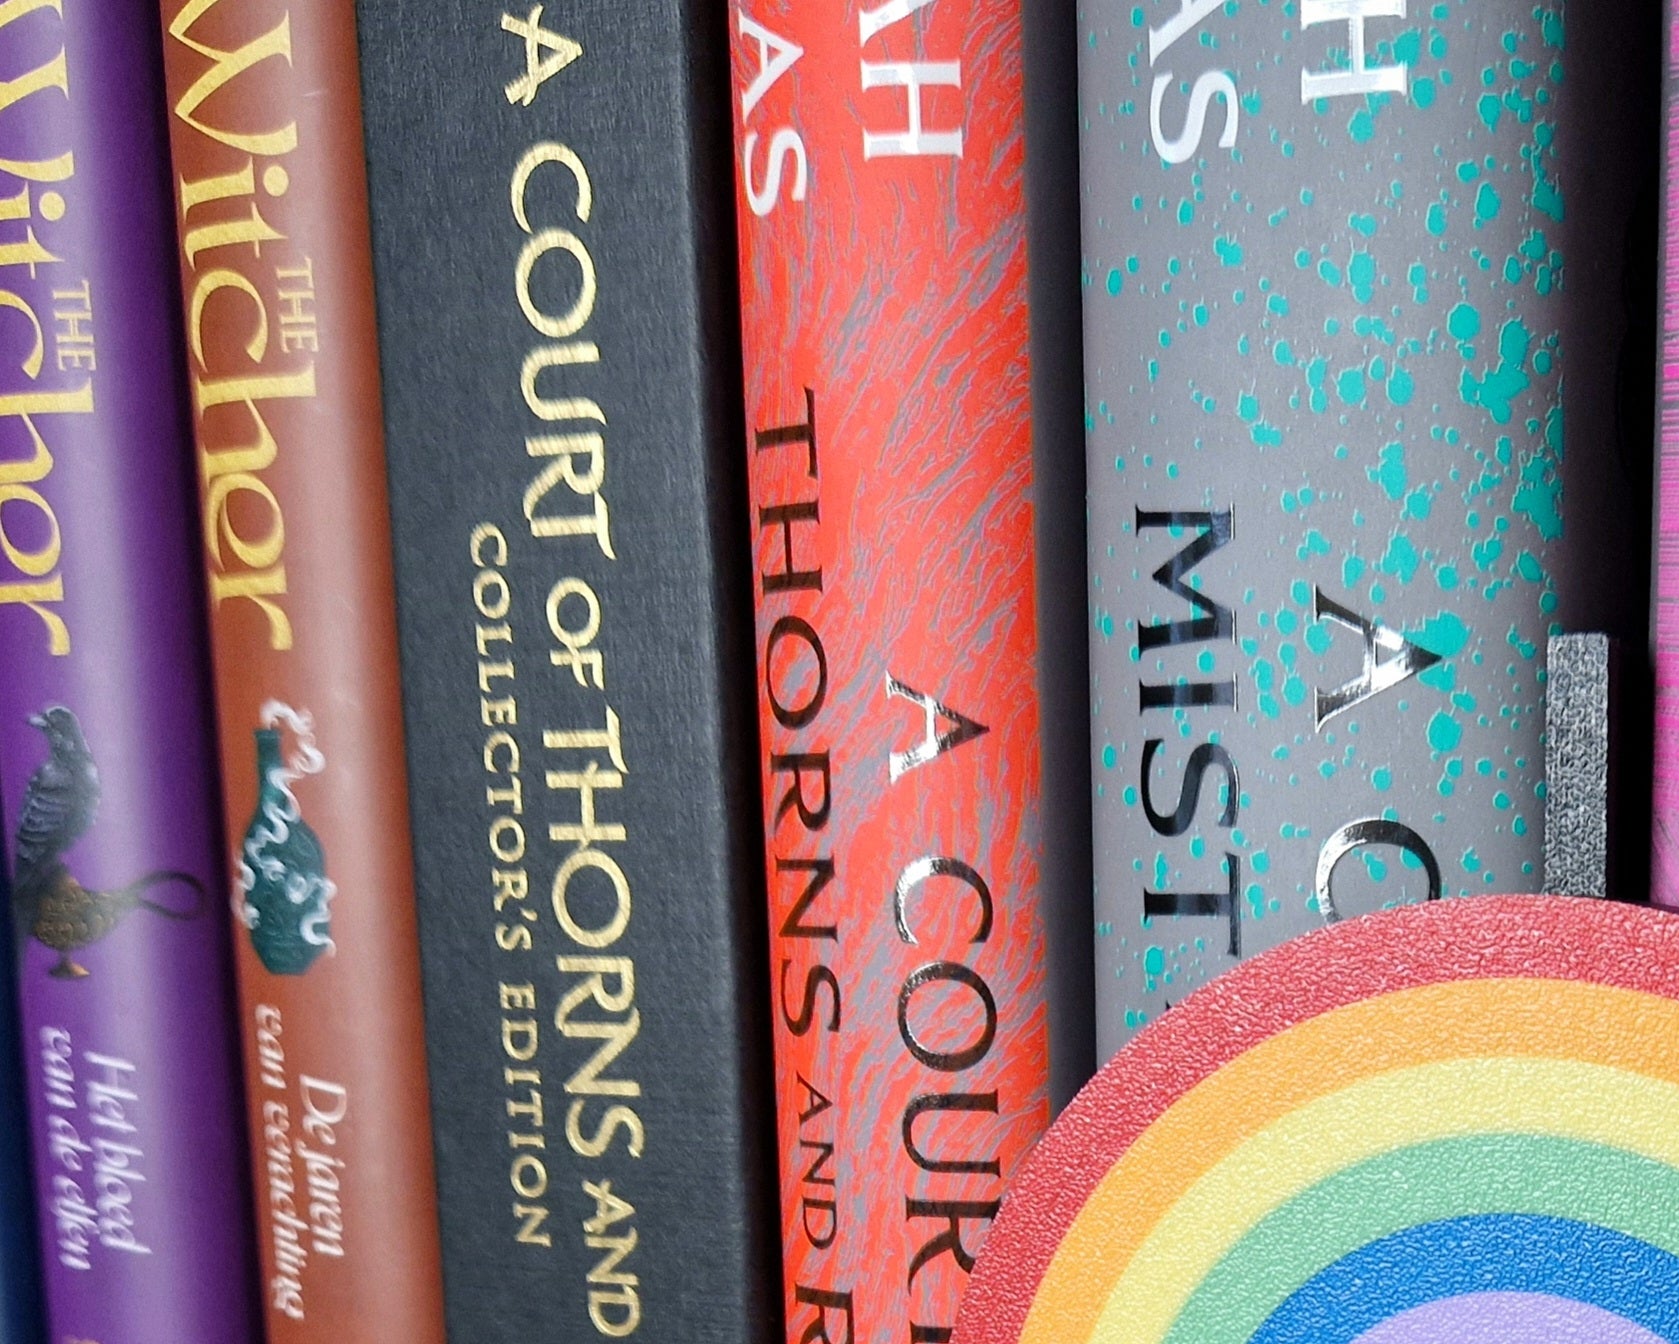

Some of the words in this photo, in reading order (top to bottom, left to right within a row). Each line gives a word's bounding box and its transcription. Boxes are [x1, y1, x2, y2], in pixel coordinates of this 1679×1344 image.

[501, 4, 583, 106] A
[738, 6, 808, 217] AS
[52, 280, 97, 372] THE
[168, 0, 317, 652] Witcher
[275, 257, 319, 353] THE
[510, 140, 617, 560] COURT
[546, 576, 604, 690] OF
[1314, 583, 1442, 733] A
[470, 521, 533, 952] COLLECTOR'S
[754, 387, 841, 1038] THORNS
[886, 671, 990, 784] A
[1135, 505, 1241, 957] MIST
[543, 705, 645, 1160] THORNS
[40, 1025, 77, 1109] van
[83, 1050, 138, 1132] Het
[255, 1003, 286, 1089] van
[48, 1115, 93, 1171] de
[299, 1075, 347, 1145] De
[500, 981, 551, 1248] EDITION
[796, 1073, 838, 1250] AND
[50, 1174, 99, 1270] elfen
[90, 1137, 153, 1255] bloed
[296, 1138, 346, 1256] jaren
[582, 1178, 642, 1337] AND
